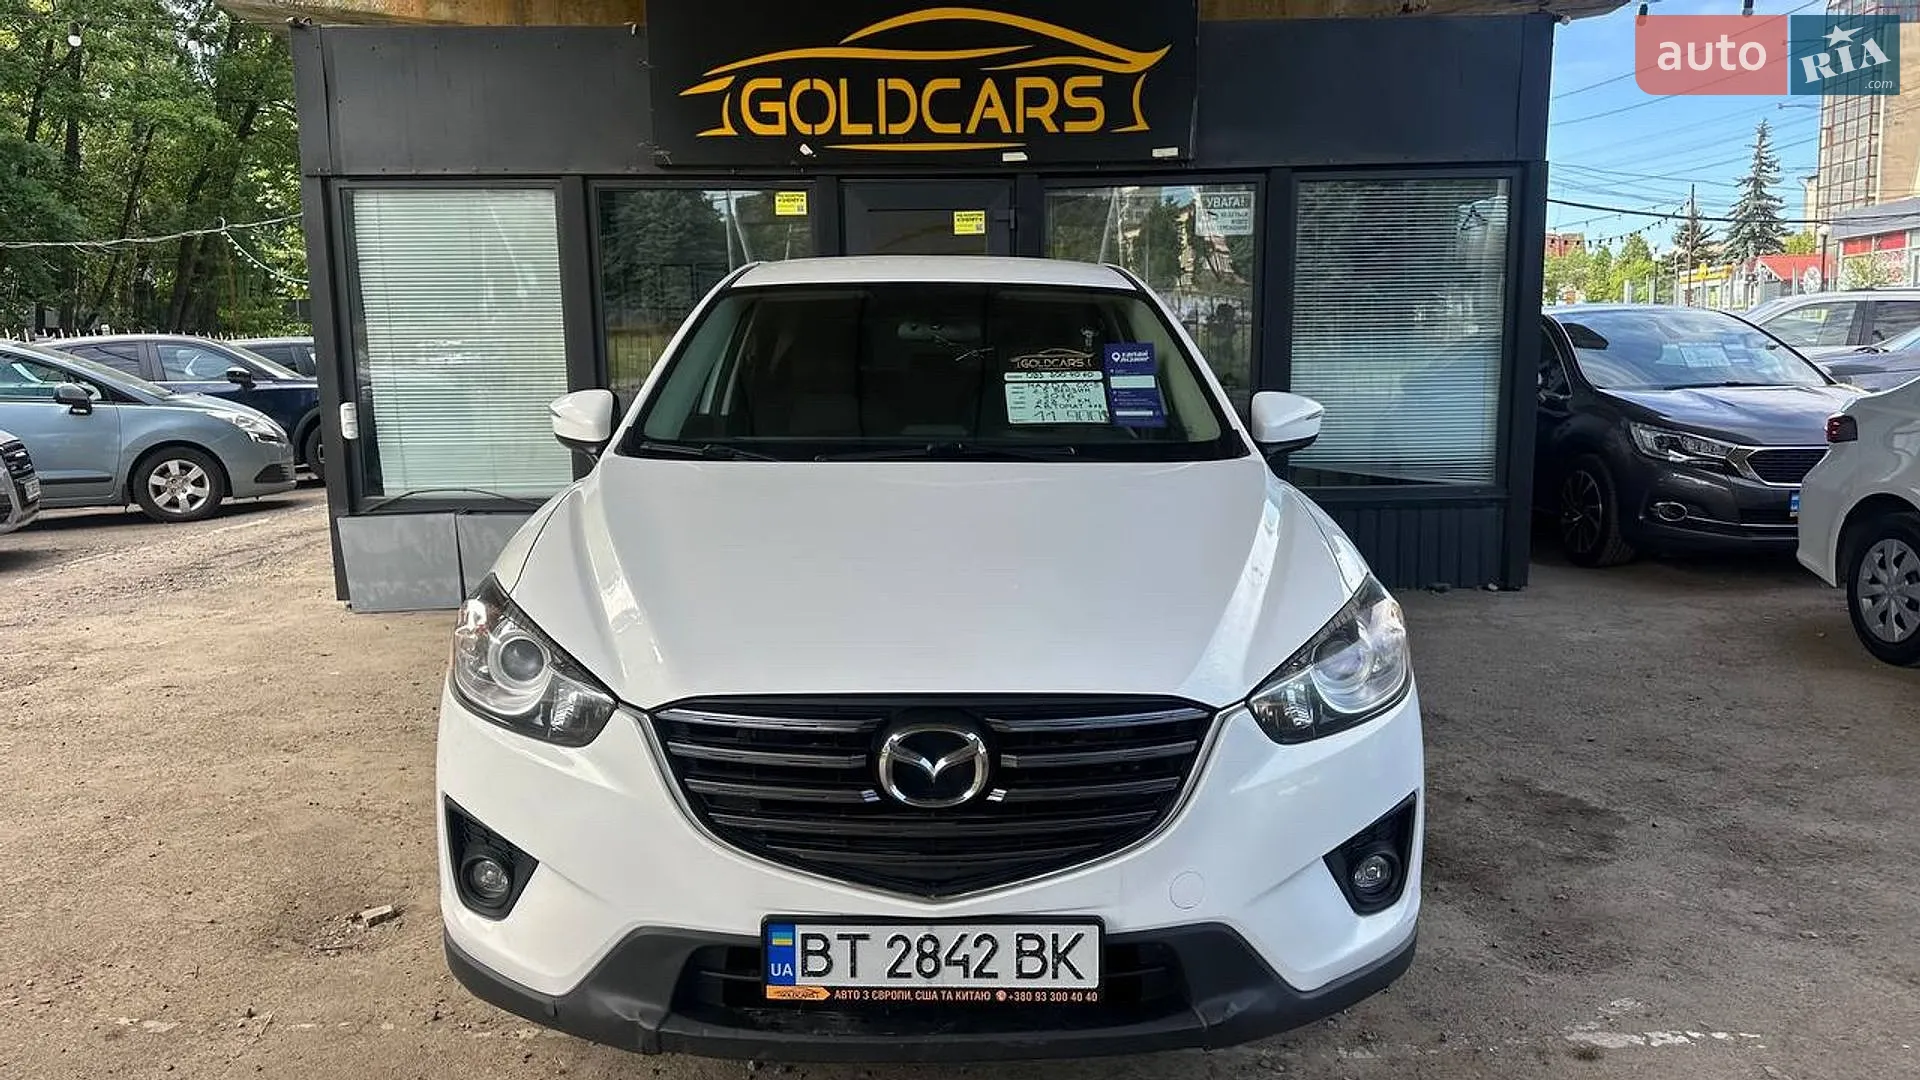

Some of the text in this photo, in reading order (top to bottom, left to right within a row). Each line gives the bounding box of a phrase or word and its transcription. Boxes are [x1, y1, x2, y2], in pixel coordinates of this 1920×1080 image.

[739, 76, 1106, 136] GOLDCARS
[770, 932, 1085, 980] UA BT 2842 BK
[833, 990, 860, 1000] АВТО
[941, 991, 953, 1001] ТА
[955, 991, 991, 1001] КИТАЮ
[1008, 991, 1032, 1002] +380
[1035, 991, 1047, 1002] 93
[1050, 991, 1068, 1002] 300
[1071, 991, 1083, 1002] 40
[1085, 991, 1098, 1002] 40
